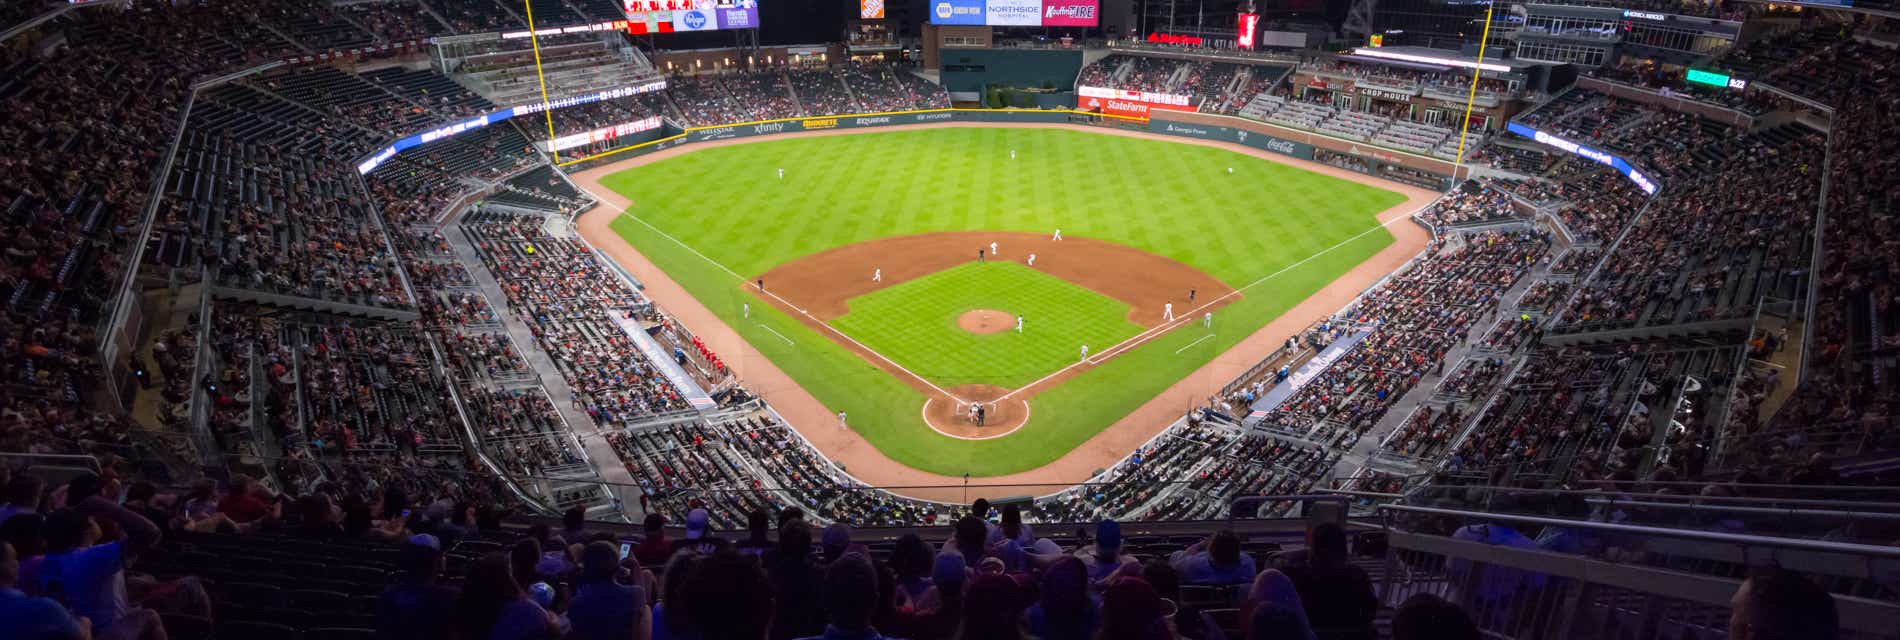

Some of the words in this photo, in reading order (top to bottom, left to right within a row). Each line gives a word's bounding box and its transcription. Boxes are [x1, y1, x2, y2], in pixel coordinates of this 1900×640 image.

[1361, 88, 1383, 97] CHOP
[1384, 91, 1410, 101] HOUSE
[856, 117, 890, 126] EQUIFAX
[753, 122, 784, 134] xfinity
